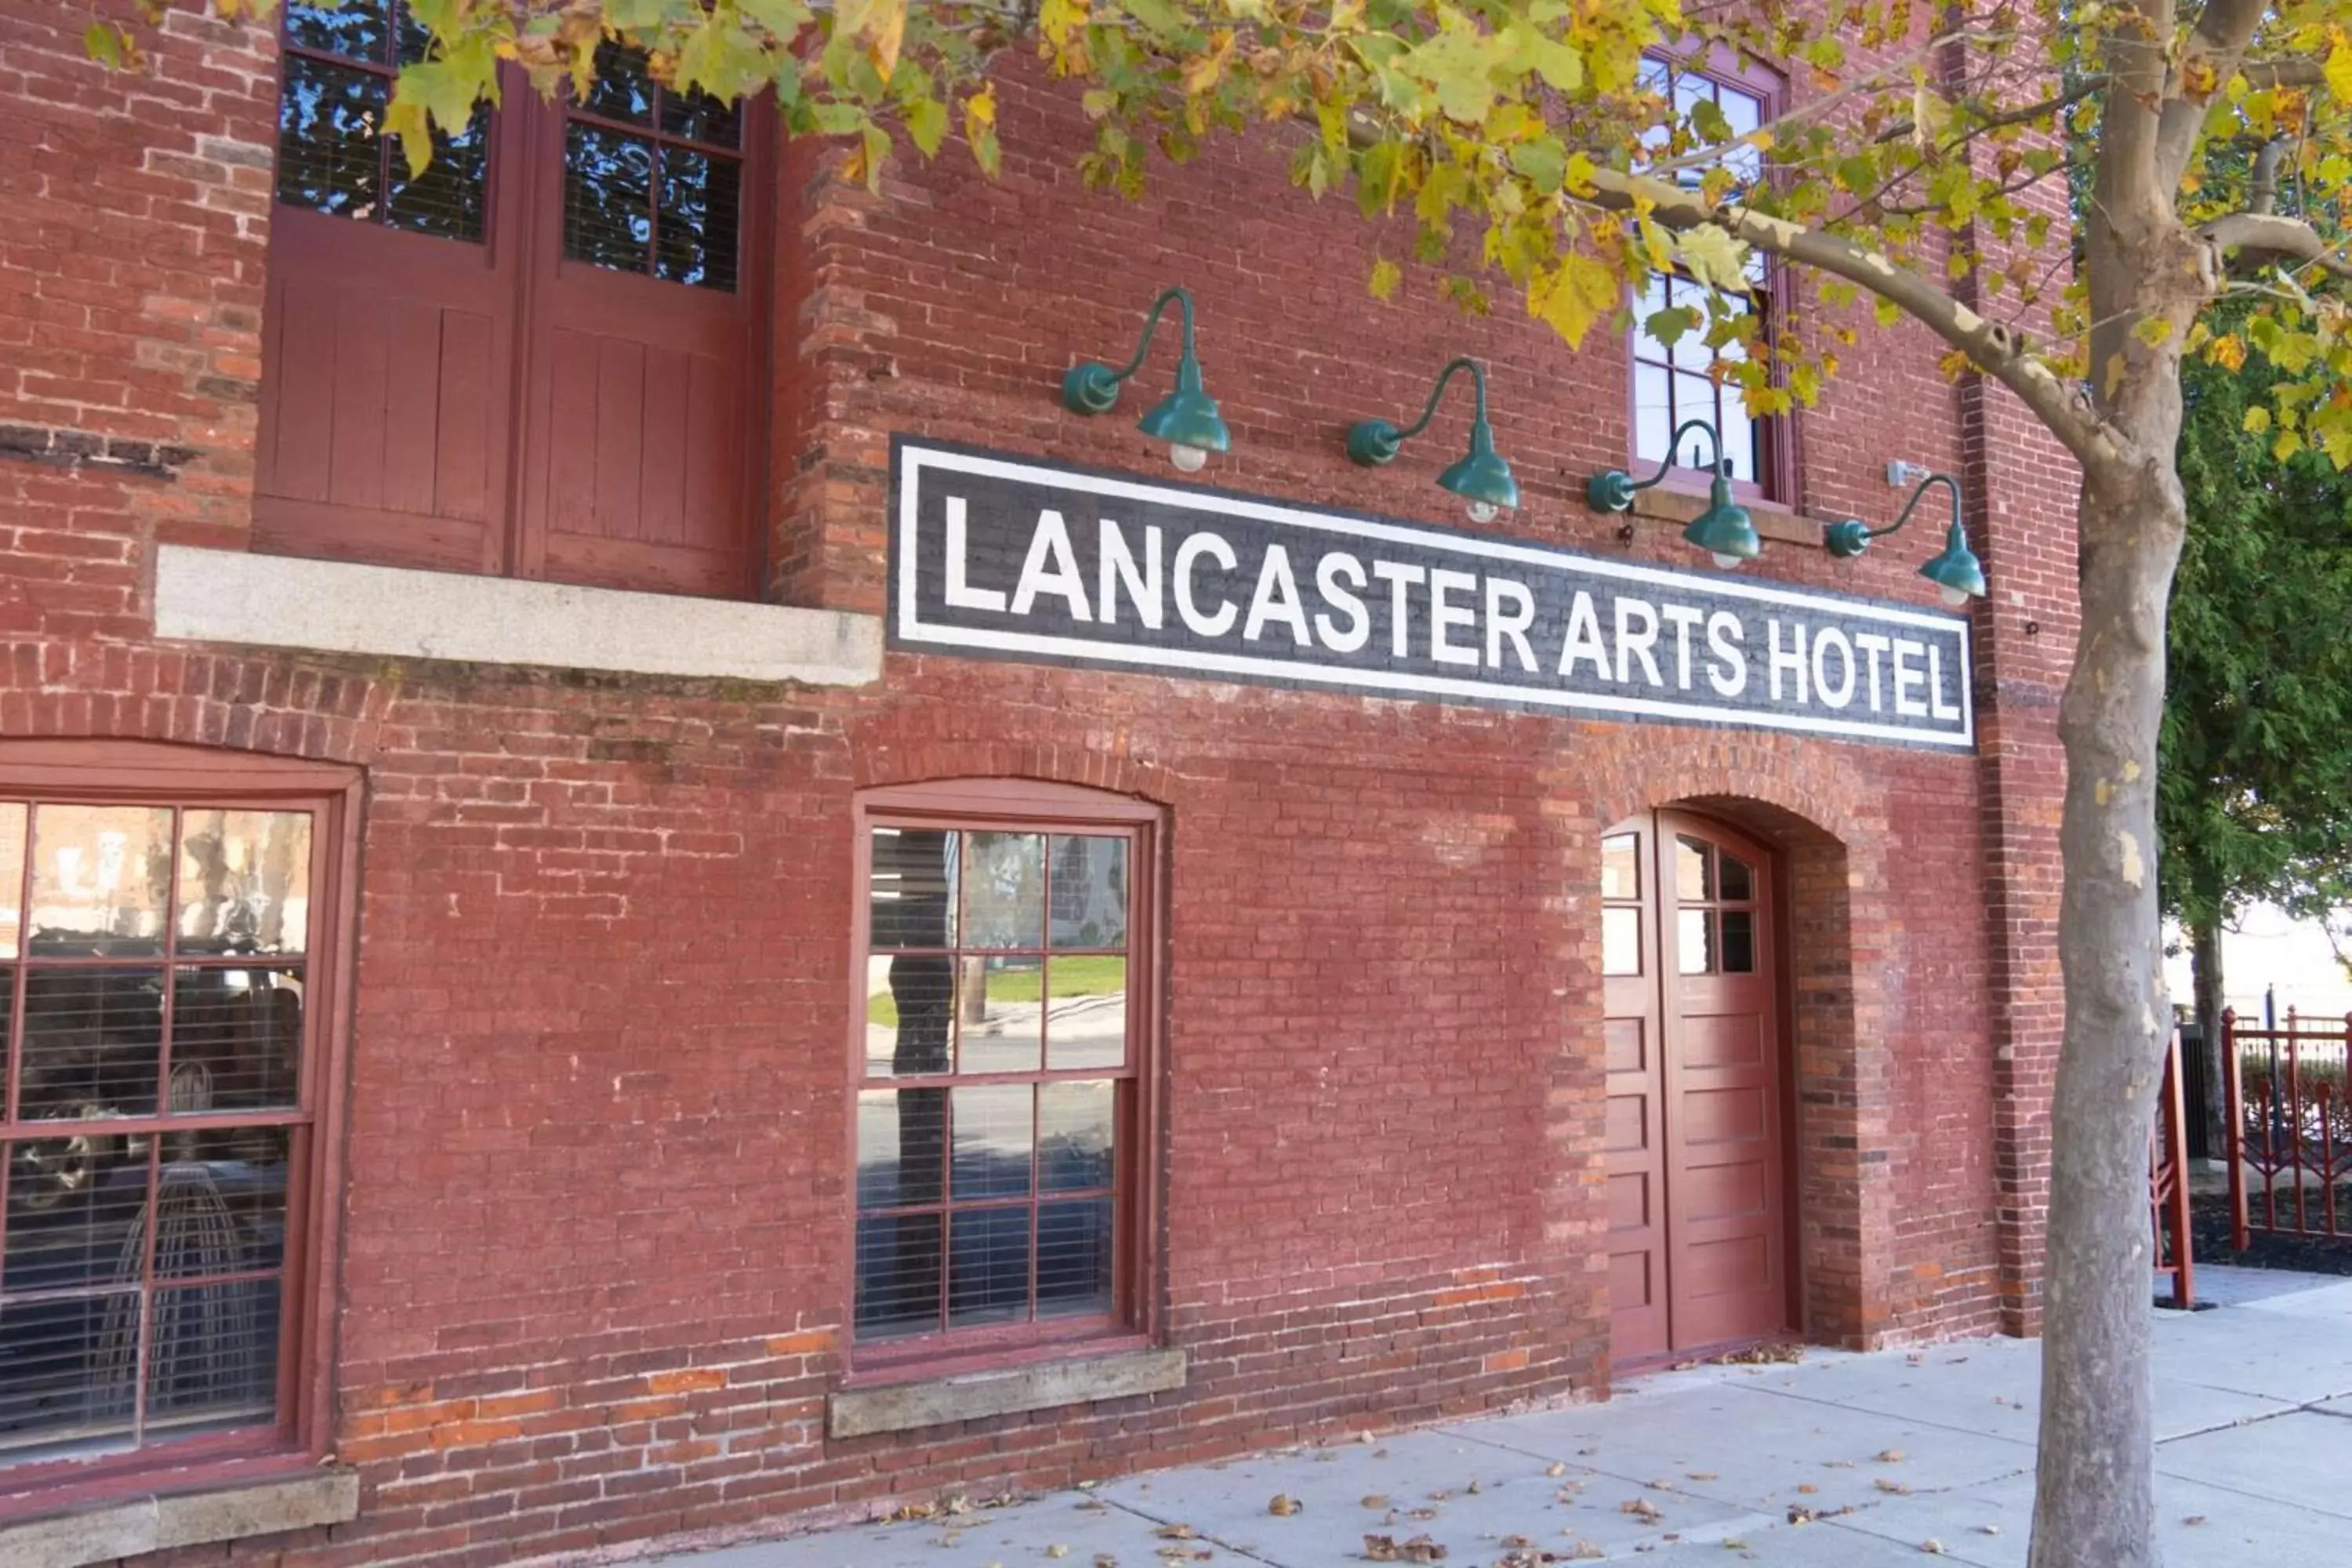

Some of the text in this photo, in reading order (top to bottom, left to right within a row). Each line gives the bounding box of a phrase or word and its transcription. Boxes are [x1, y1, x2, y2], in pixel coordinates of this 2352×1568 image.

[945, 497, 1958, 720] LANCASTER ARTS HOTEL
